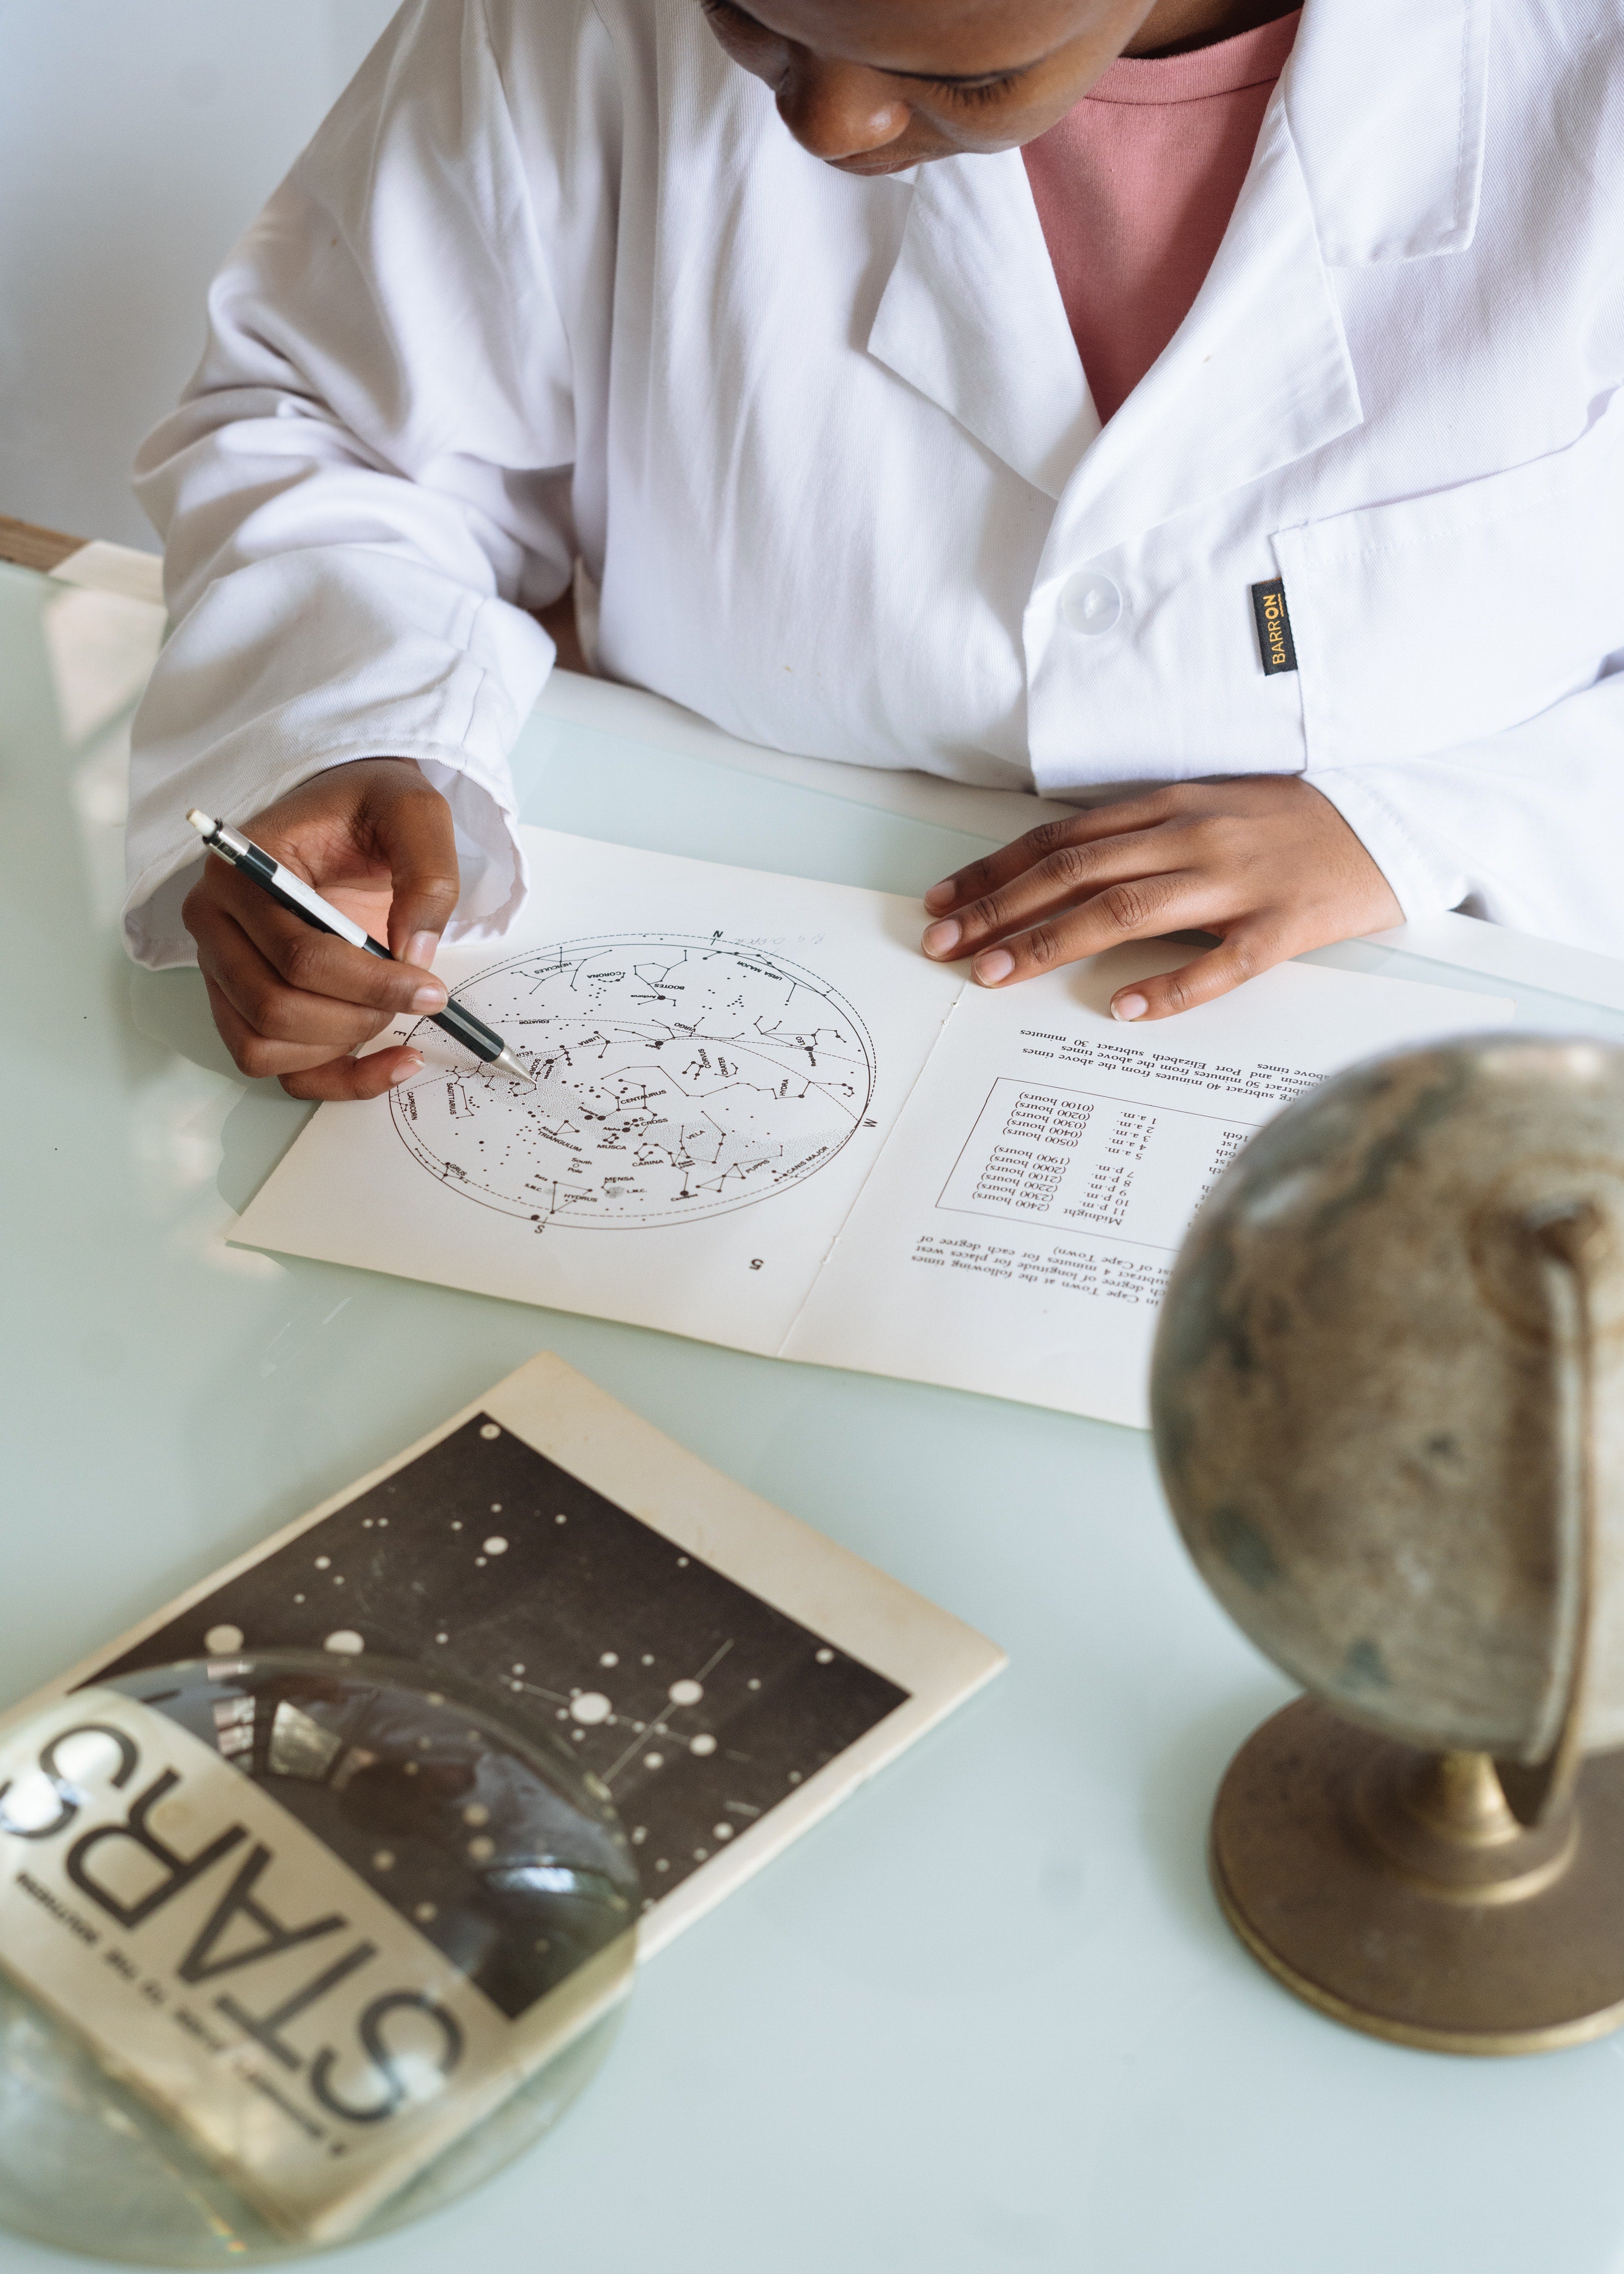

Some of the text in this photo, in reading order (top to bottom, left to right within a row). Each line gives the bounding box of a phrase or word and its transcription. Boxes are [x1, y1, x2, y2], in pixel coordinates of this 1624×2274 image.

[1263, 594, 1285, 665] BARRON
[534, 962, 572, 974] HERCULES
[737, 961, 782, 980] URSA MAJOR
[587, 971, 622, 979] CORONA
[674, 1022, 696, 1032] VIRGO
[577, 1035, 600, 1046] LIBRA
[795, 1036, 805, 1046] LEO
[698, 1049, 711, 1068] CORVUS
[1020, 1029, 1318, 1087] ontein and Port Elizabeth subtract 30 minutes
[1022, 1048, 1055, 1059] times
[1058, 1054, 1094, 1066] above
[718, 1057, 728, 1075] CRATER
[1061, 1046, 1308, 1097] ubtract 50 minutes from the above times
[1097, 1061, 1117, 1071] the
[1121, 1066, 1152, 1078] from
[1257, 1063, 1289, 1075] times
[1155, 1072, 1204, 1086] minutes
[779, 1079, 789, 1096] HYDRA
[1206, 1082, 1222, 1091] 40
[1225, 1085, 1275, 1099] subtract
[447, 1082, 456, 1115] SAGITTARIUS
[620, 1089, 667, 1104] CENTAURUS
[1019, 1091, 1059, 1107] hours)
[407, 1092, 417, 1120] CAPRICORN
[1015, 1100, 1055, 1115] hours)
[1061, 1101, 1094, 1113] (0100
[641, 1118, 668, 1126] CROSS
[1011, 1108, 1050, 1124] hours)
[1057, 1109, 1090, 1122] (0200
[863, 1119, 878, 1127] W
[1007, 1117, 1046, 1133] hours)
[1053, 1118, 1087, 1130] (0300
[686, 1130, 705, 1139] VELA
[1002, 1126, 1042, 1142] hours)
[1048, 1126, 1083, 1140] (0400
[1146, 1126, 1155, 1134] 2
[538, 1131, 582, 1152] TRIANGULUM
[1044, 1135, 1079, 1148] (0500
[1143, 1135, 1152, 1143] 3
[1223, 1131, 1249, 1143] 16th
[1220, 1140, 1238, 1150] 1st
[993, 1144, 1034, 1160] hours)
[1135, 1153, 1143, 1161] 5
[746, 1159, 770, 1173] PUPPIS
[786, 1146, 828, 1174] CANIS MAJOR
[989, 1153, 1030, 1169] hours)
[1036, 1154, 1071, 1166] (1900
[450, 1163, 467, 1176] GRUS
[985, 1162, 1025, 1178] hours)
[1032, 1162, 1067, 1175] (2000
[1126, 1171, 1134, 1179] 7
[980, 1172, 1021, 1188] hours)
[1028, 1172, 1062, 1185] (2100
[1123, 1179, 1132, 1188] 8
[976, 1181, 1017, 1197] hours)
[1024, 1181, 1058, 1193] (2200
[1119, 1189, 1127, 1197] 9
[1019, 1190, 1054, 1203] (2300
[1115, 1198, 1130, 1207] 10
[972, 1191, 1123, 1226] Midnight (2400 hours)
[1113, 1207, 1126, 1217] 11
[535, 1225, 545, 1234] S
[917, 1236, 934, 1244] of
[939, 1239, 981, 1252] degree
[916, 1245, 944, 1255] west
[950, 1250, 989, 1263] places
[987, 1246, 1016, 1256] each
[1053, 1246, 1095, 1263] Town)
[911, 1255, 945, 1266] times
[993, 1257, 1012, 1268] for
[1021, 1252, 1040, 1263] for
[1101, 1257, 1134, 1270] Cape
[750, 1259, 763, 1270] 5
[951, 1259, 1013, 1279] following
[1047, 1257, 1097, 1272] minutes
[1136, 1264, 1153, 1272] of
[1017, 1262, 1078, 1281] longitude
[1018, 1273, 1038, 1283] the
[1103, 1268, 1111, 1276] 4
[1080, 1274, 1096, 1283] of
[1061, 1281, 1098, 1296] Town
[1102, 1278, 1144, 1294] degree
[1106, 1290, 1140, 1303] Cape
[0, 1724, 464, 2123] STARS
